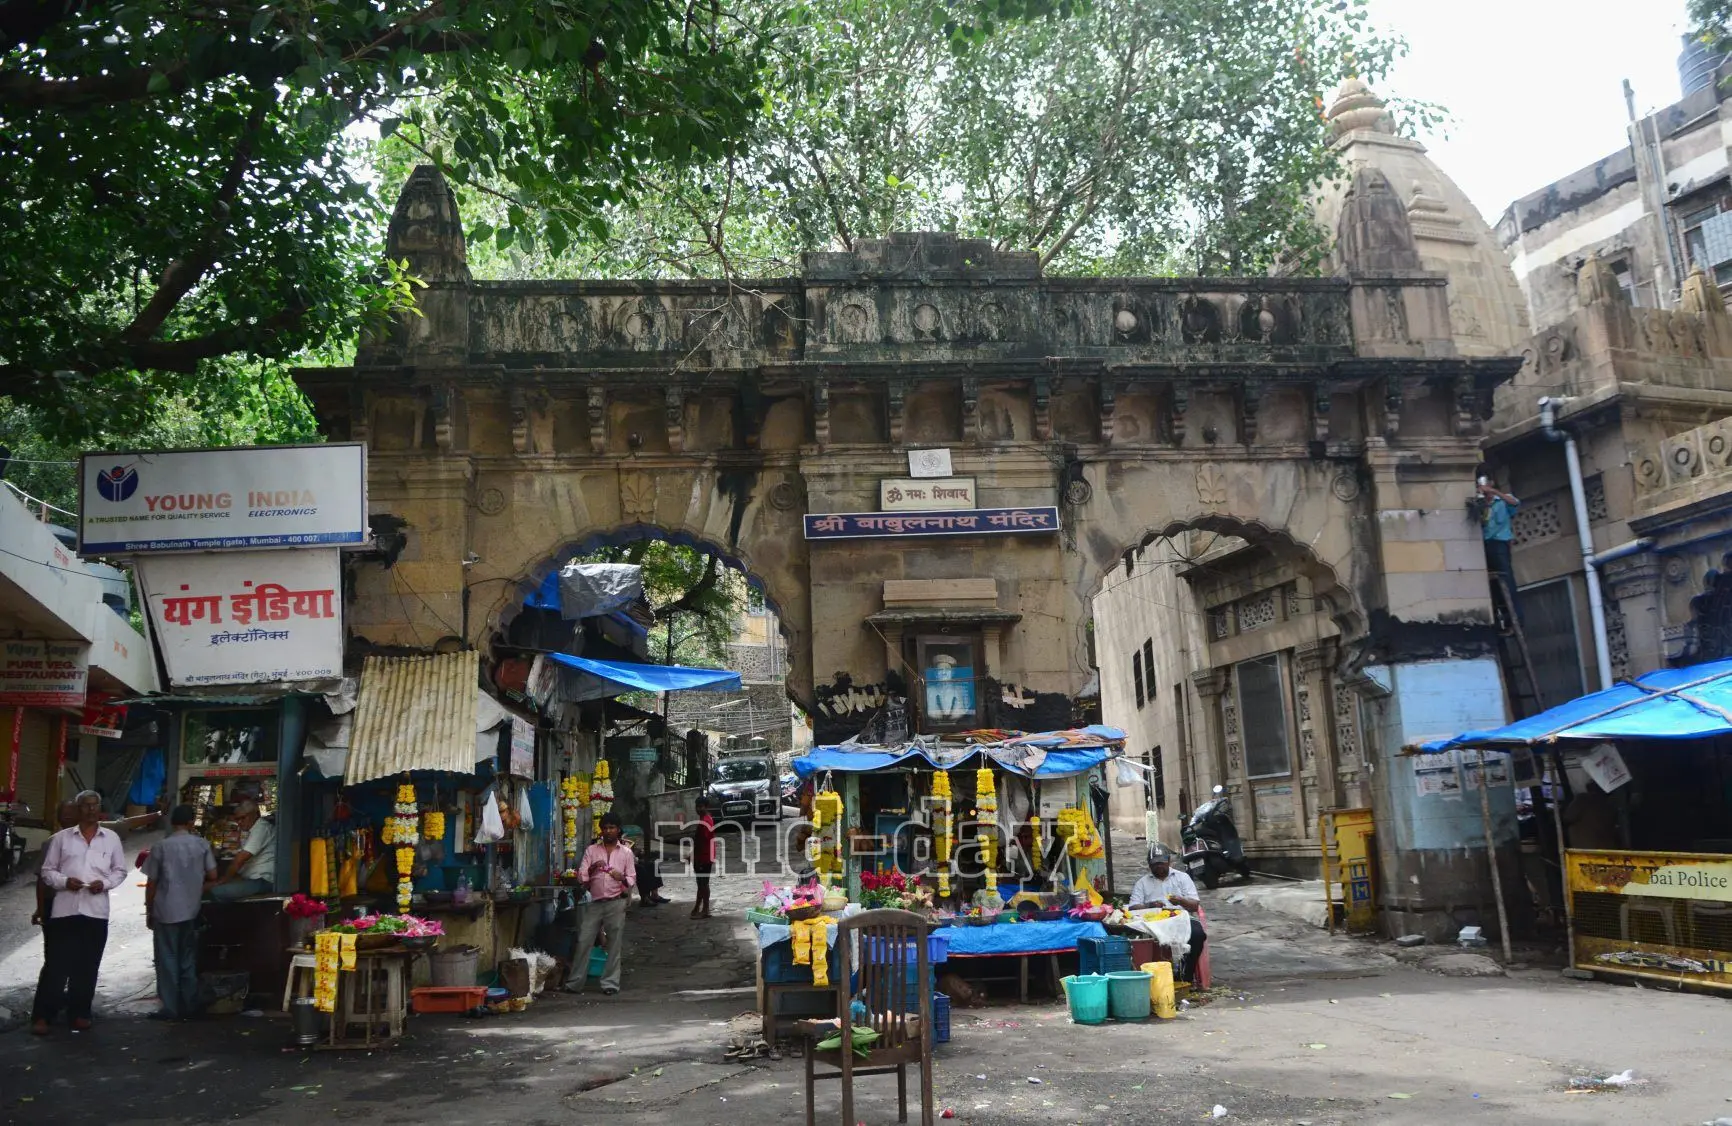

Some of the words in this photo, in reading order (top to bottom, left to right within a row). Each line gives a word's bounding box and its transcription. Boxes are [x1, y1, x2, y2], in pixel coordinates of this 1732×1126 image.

[144, 491, 232, 512] YOUNG
[248, 489, 317, 508] INDIA
[904, 488, 926, 500] नमः
[200, 511, 230, 519] SERVICE
[248, 507, 317, 518] ELECTRONICS
[812, 514, 847, 531] श्री
[854, 515, 979, 532] बाबुलनाथ
[987, 511, 1050, 528] मंदिर
[125, 543, 149, 551] Shree
[150, 541, 191, 550] Babulnath
[193, 539, 221, 549] Temple
[249, 536, 281, 545] Mumbai
[162, 584, 222, 625] यंग
[230, 580, 335, 625] इंडिया
[7, 661, 43, 670] PURE
[1678, 871, 1728, 888] Police
